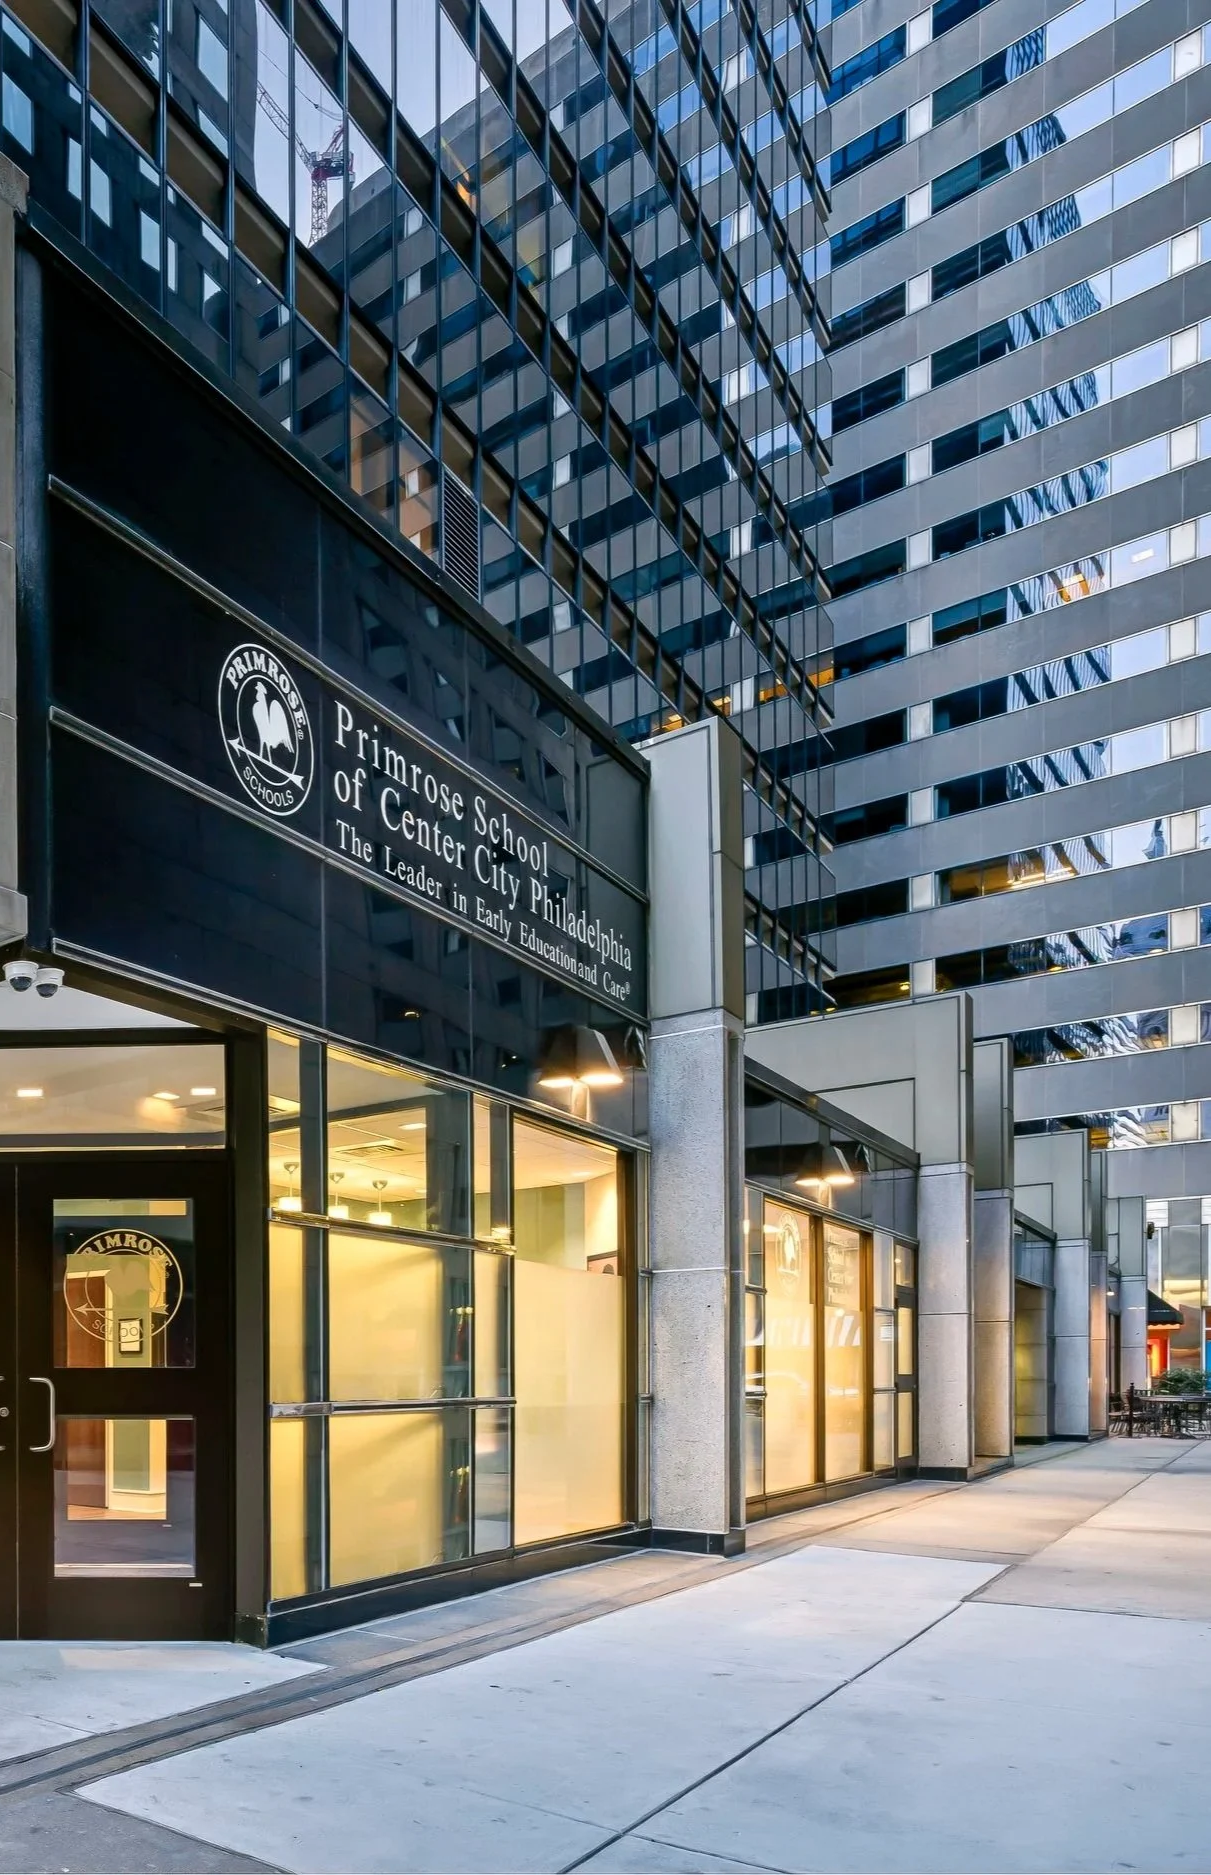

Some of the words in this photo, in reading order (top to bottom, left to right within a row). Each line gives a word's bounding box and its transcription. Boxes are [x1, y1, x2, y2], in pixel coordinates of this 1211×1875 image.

[243, 766, 294, 807] SCHOOLS
[334, 700, 464, 821] Primrose
[474, 796, 549, 877] School
[334, 767, 367, 812] of
[380, 787, 466, 870] Center
[474, 844, 520, 910] City
[530, 876, 632, 971] Philadelphia
[335, 819, 373, 862] The
[384, 845, 443, 899] Leader
[453, 883, 469, 915] in
[475, 896, 512, 942] Early
